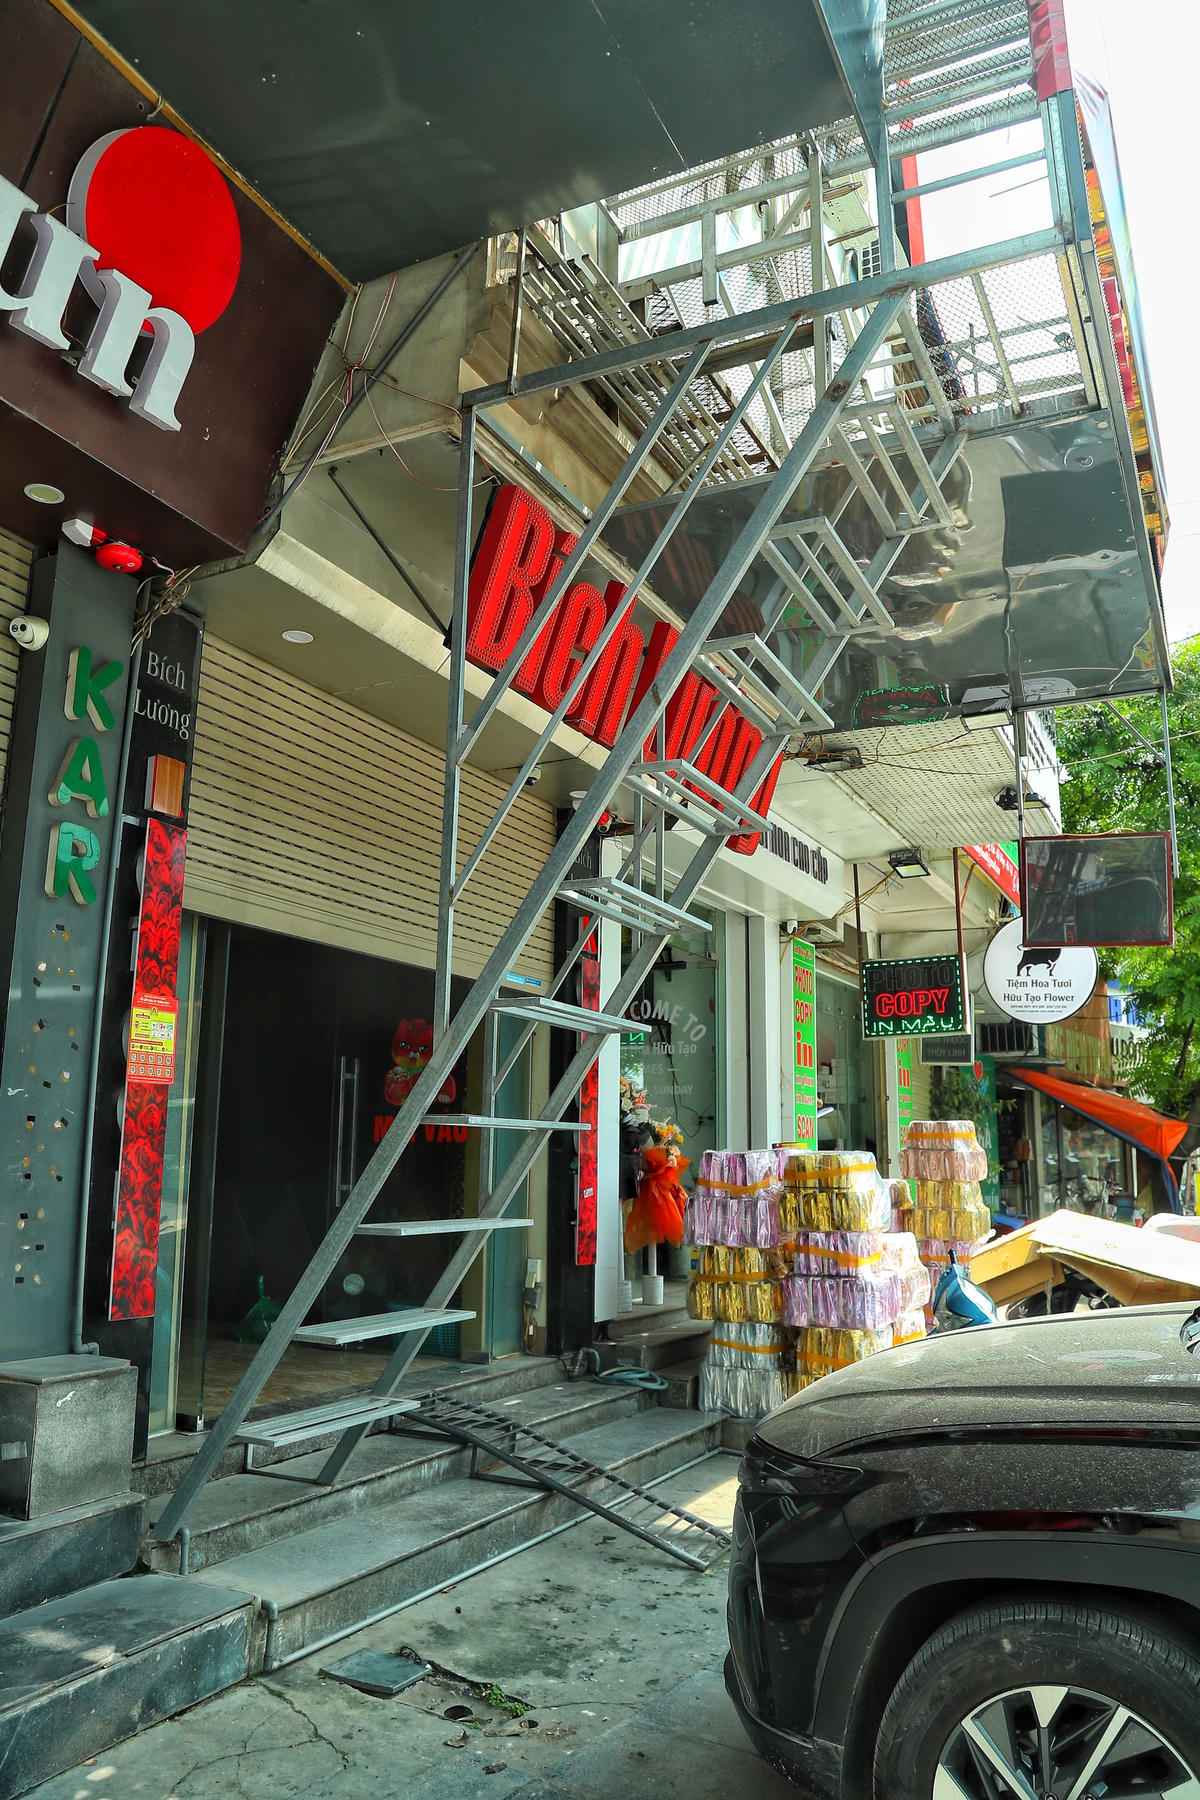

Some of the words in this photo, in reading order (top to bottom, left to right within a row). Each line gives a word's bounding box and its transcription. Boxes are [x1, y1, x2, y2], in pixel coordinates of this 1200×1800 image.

[146, 650, 187, 691] Bích
[134, 687, 191, 740] Lương
[791, 836, 809, 875] CAO
[794, 965, 813, 995] PHOTO
[867, 964, 955, 992] PHOTO
[1006, 979, 1028, 990] Tiệm
[1031, 979, 1049, 988] Hoa
[795, 998, 813, 1026] COPY
[876, 988, 949, 1017] COPY
[1003, 993, 1022, 1002] Hữu
[1024, 993, 1042, 1004] Tạo
[1044, 993, 1075, 1002] Flower
[629, 999, 682, 1026] COME
[683, 1013, 707, 1042] TO
[873, 1020, 894, 1032] IN
[796, 1030, 813, 1068] in
[652, 1085, 694, 1096] SUNDAY
[797, 1114, 814, 1139] SCAN
